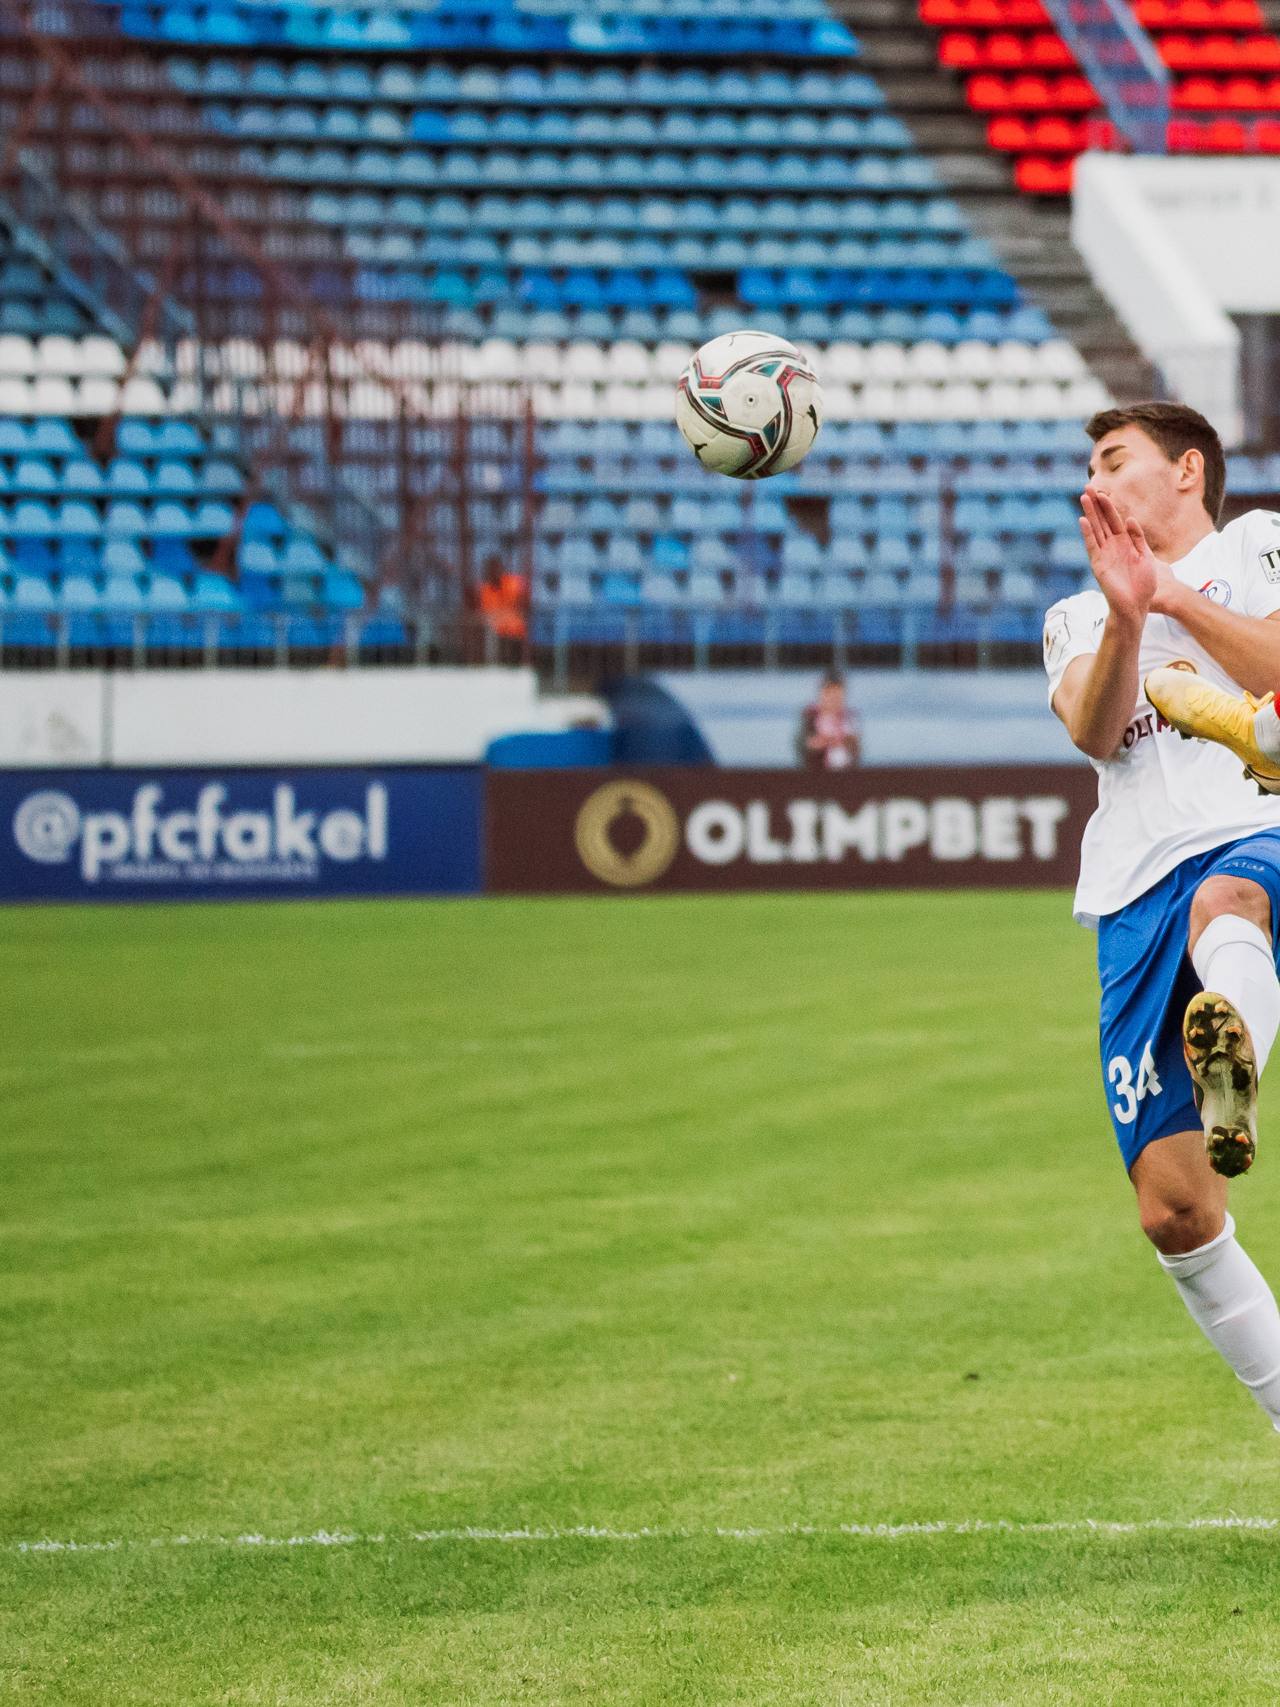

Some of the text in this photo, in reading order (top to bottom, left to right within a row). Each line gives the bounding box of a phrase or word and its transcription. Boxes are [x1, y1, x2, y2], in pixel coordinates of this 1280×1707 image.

[1123, 713, 1176, 750] OLIM
[13, 781, 389, 882] @pfcfakel
[685, 799, 1068, 865] OLIMPBET
[1108, 1040, 1163, 1124] 34
